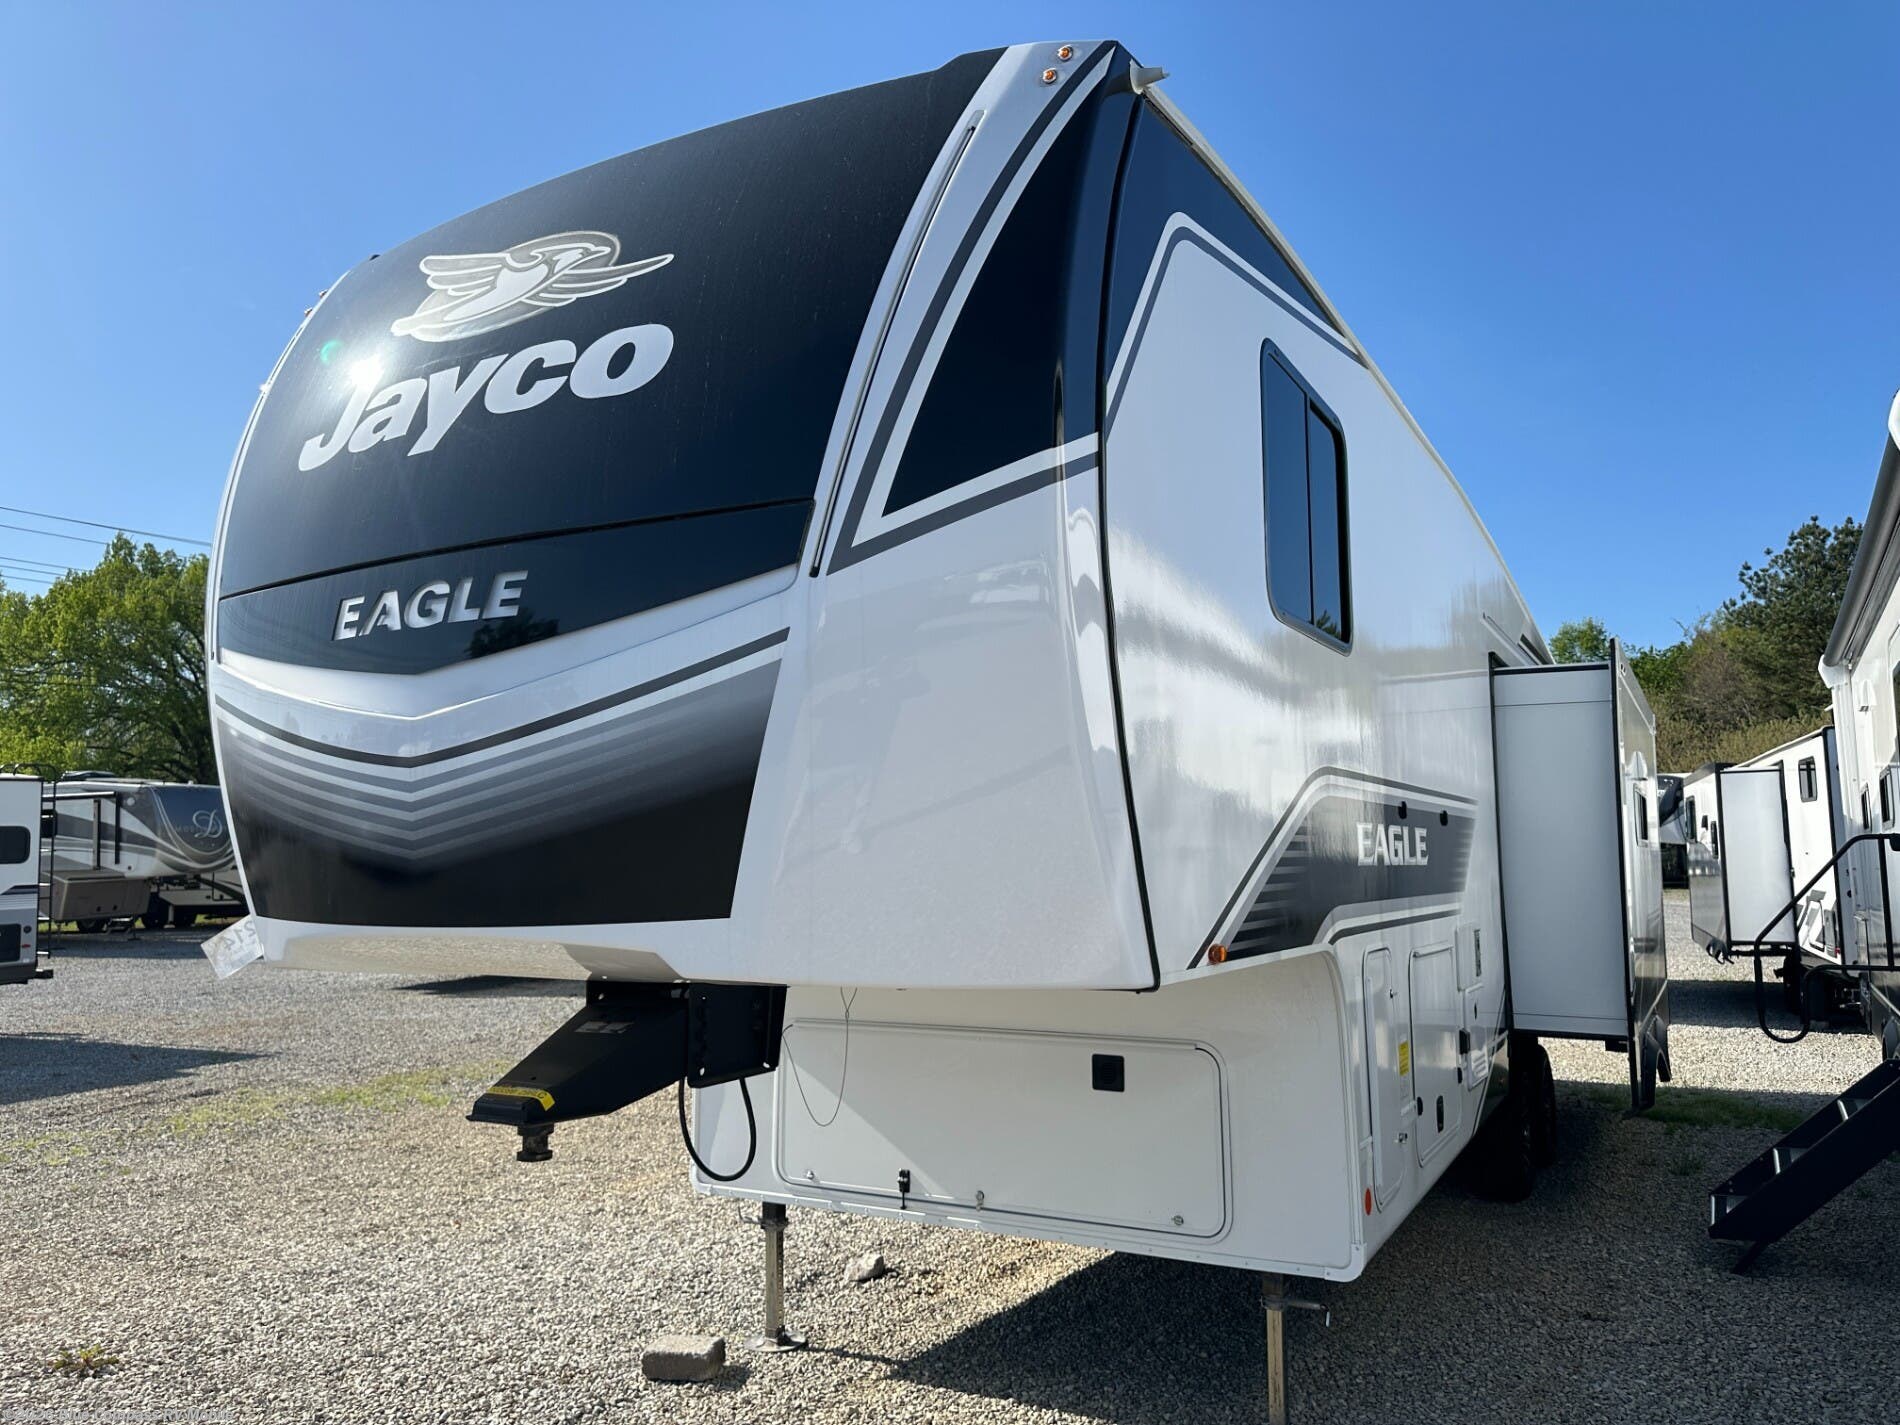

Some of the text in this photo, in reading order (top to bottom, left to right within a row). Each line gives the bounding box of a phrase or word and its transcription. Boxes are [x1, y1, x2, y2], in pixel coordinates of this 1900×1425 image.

[298, 323, 674, 472] Jayco
[332, 570, 528, 641] EAGLE
[1356, 822, 1429, 866] EAGLE
